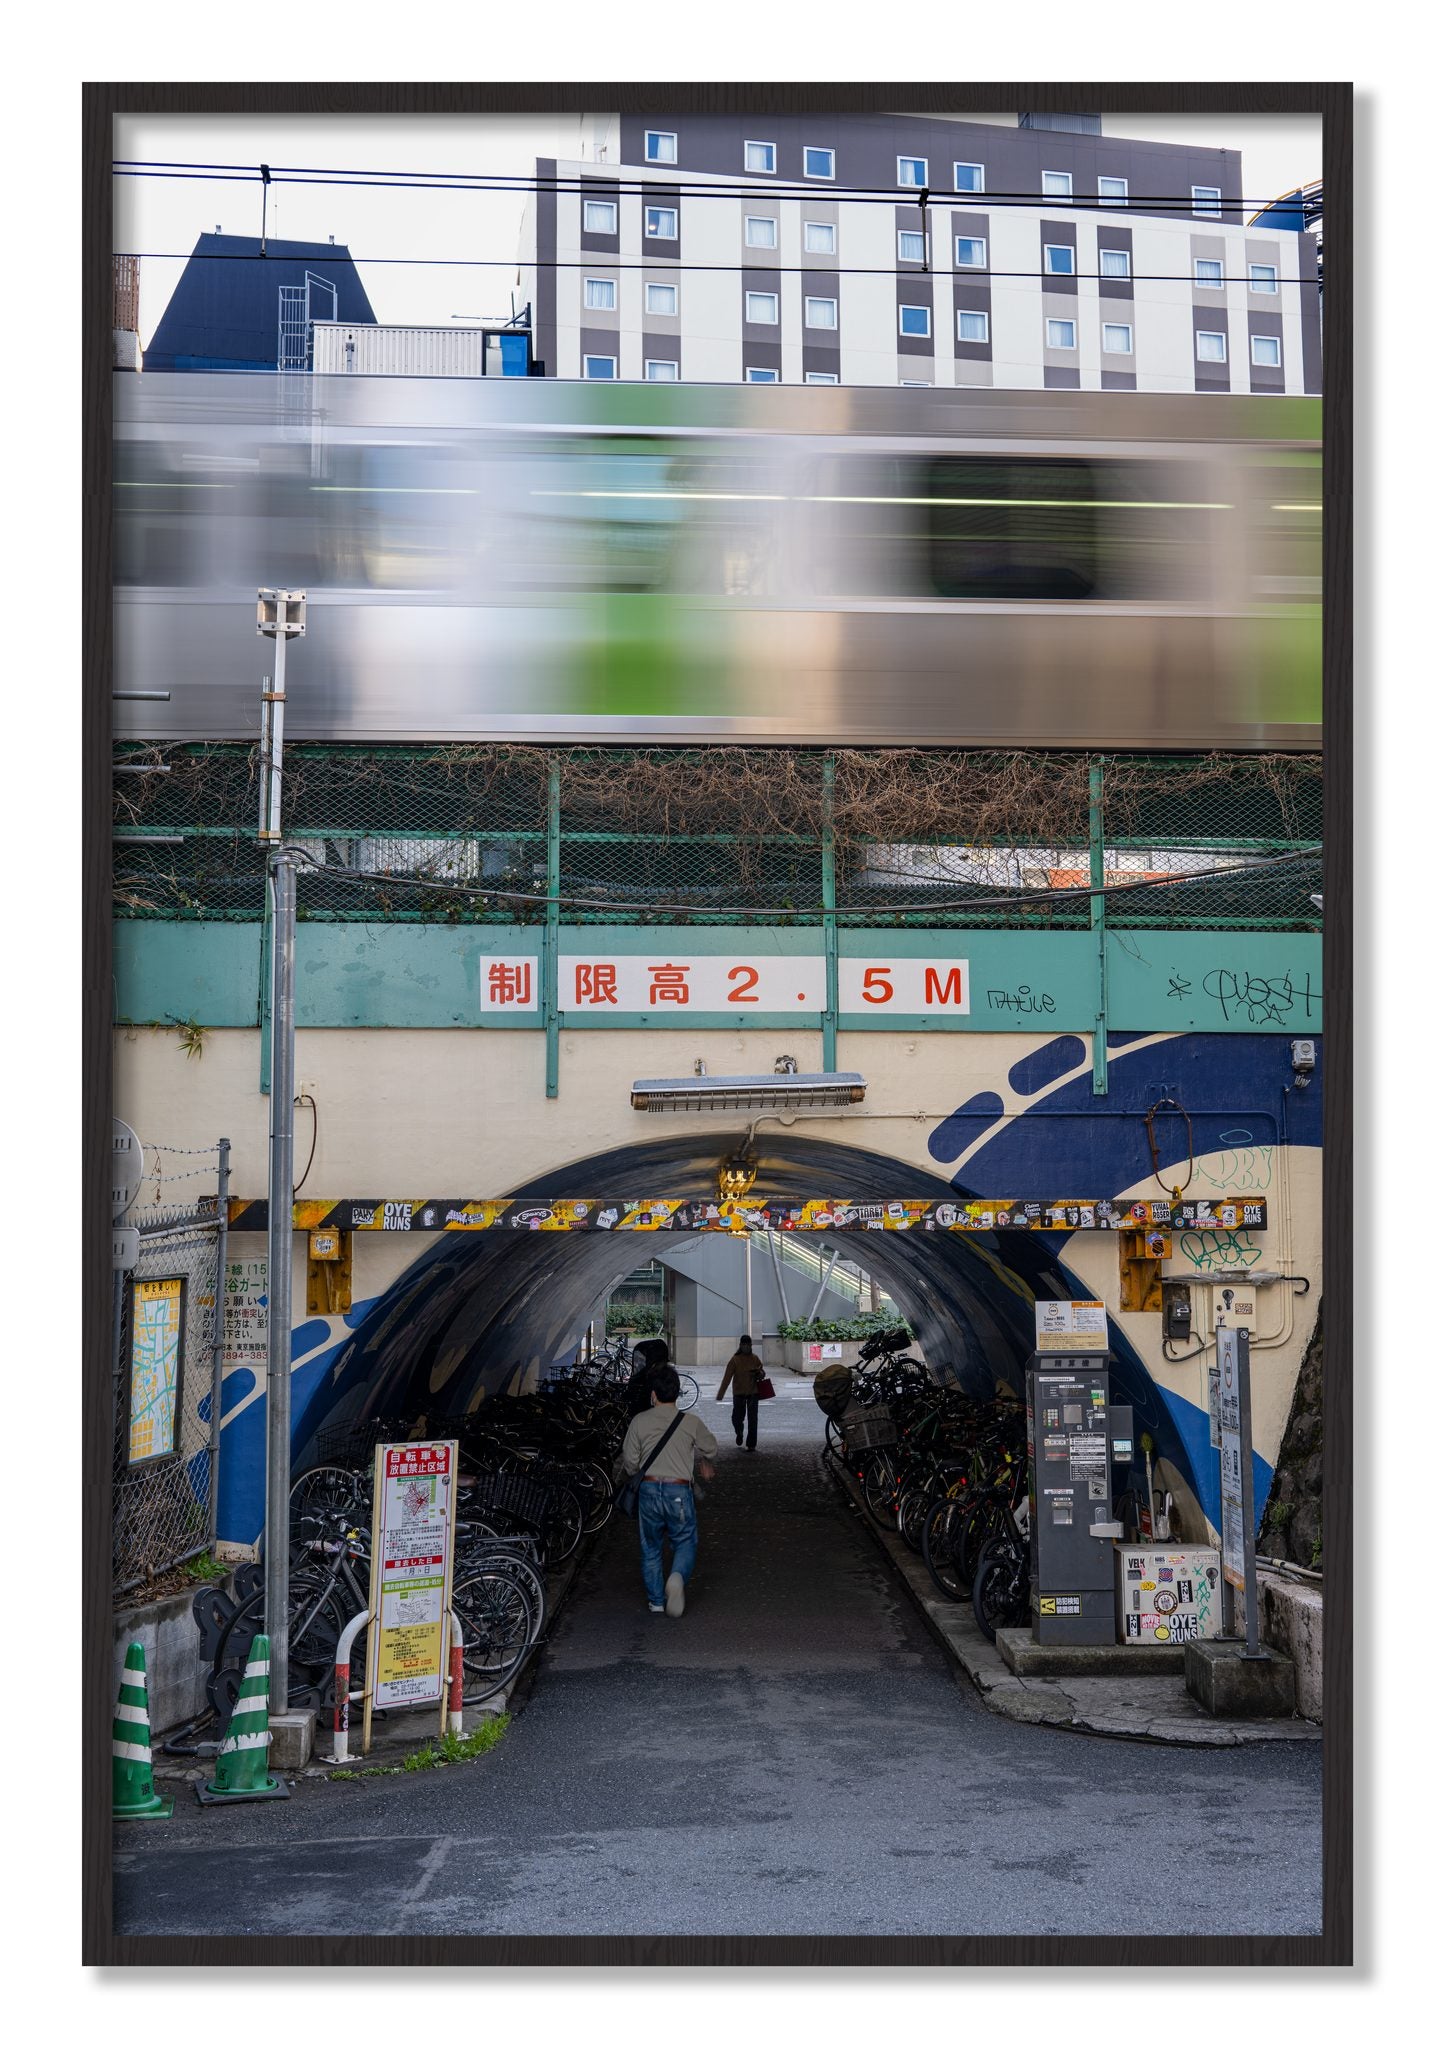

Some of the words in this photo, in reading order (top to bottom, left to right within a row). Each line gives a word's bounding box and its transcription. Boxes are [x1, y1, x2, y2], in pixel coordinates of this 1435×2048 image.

[384, 1202, 412, 1217] OYE
[383, 1216, 411, 1230] RUNS
[390, 1461, 446, 1475] 放置禁止区域
[1170, 1614, 1197, 1628] OYE
[1170, 1627, 1198, 1643] RUNS
